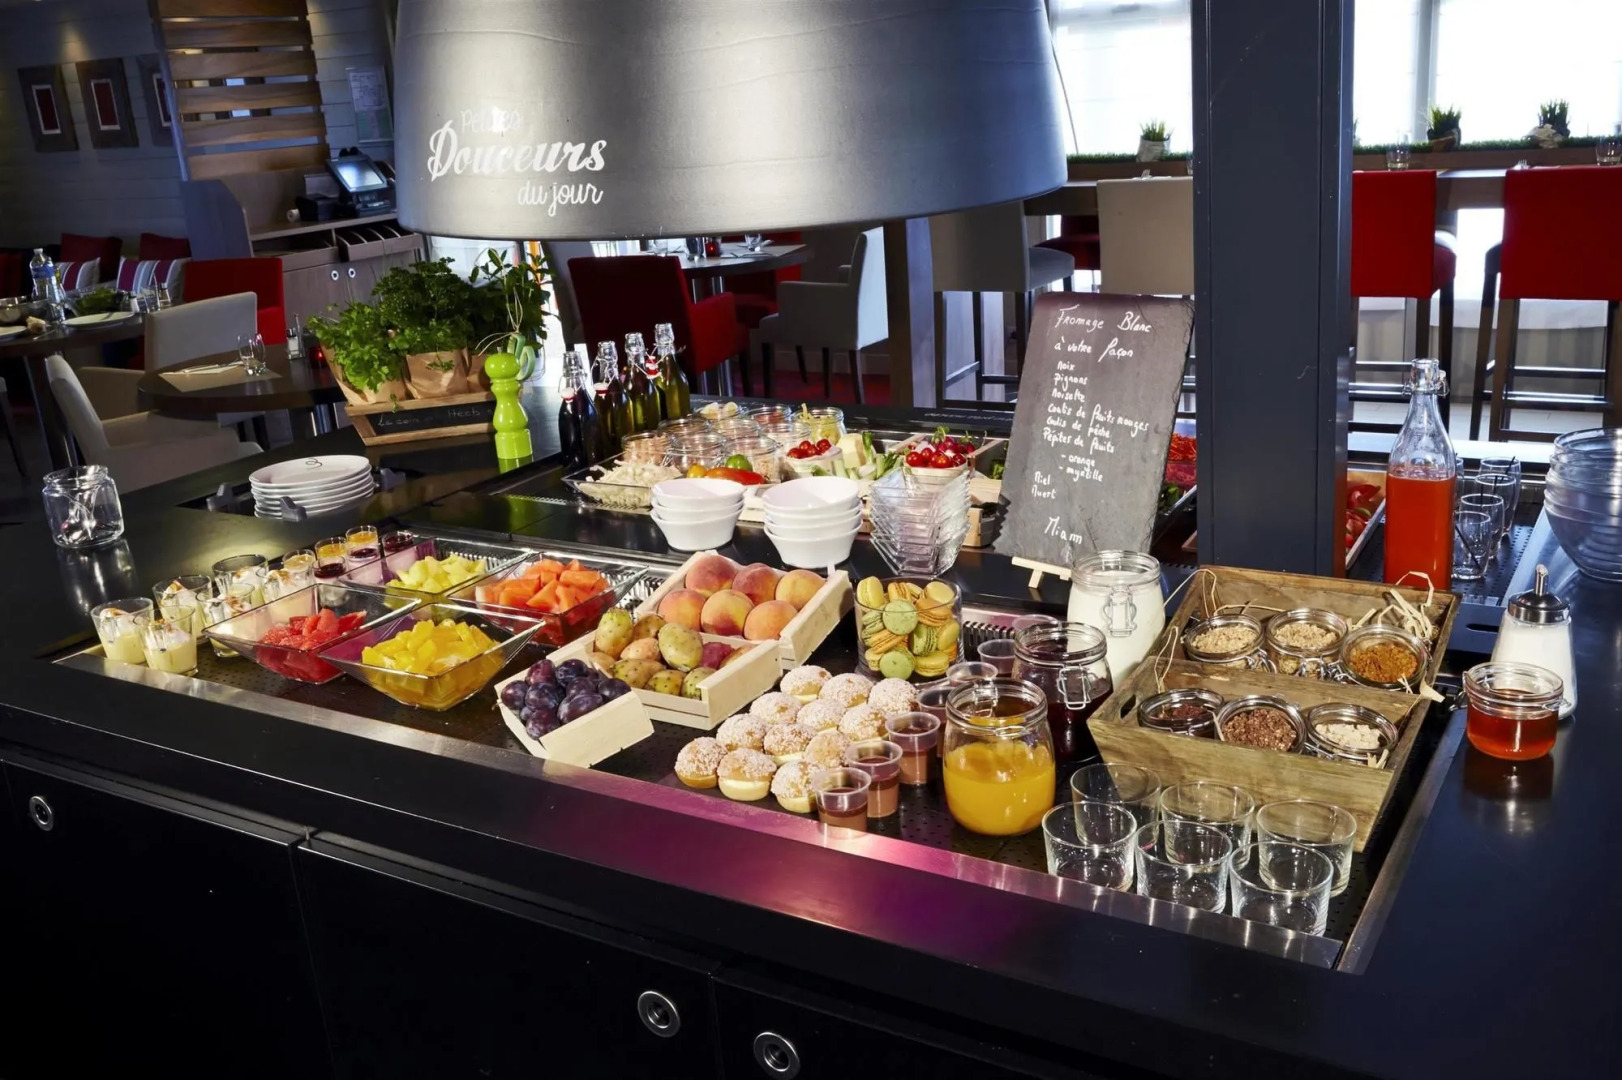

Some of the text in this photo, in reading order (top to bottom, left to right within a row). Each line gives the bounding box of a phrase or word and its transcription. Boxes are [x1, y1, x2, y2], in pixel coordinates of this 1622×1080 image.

[427, 119, 607, 182] Douceurs
[518, 181, 604, 217] du jour
[1054, 303, 1153, 334] Fromage Blanc
[1067, 339, 1092, 354] votre
[1097, 337, 1134, 363] façon
[1068, 454, 1096, 472] orange
